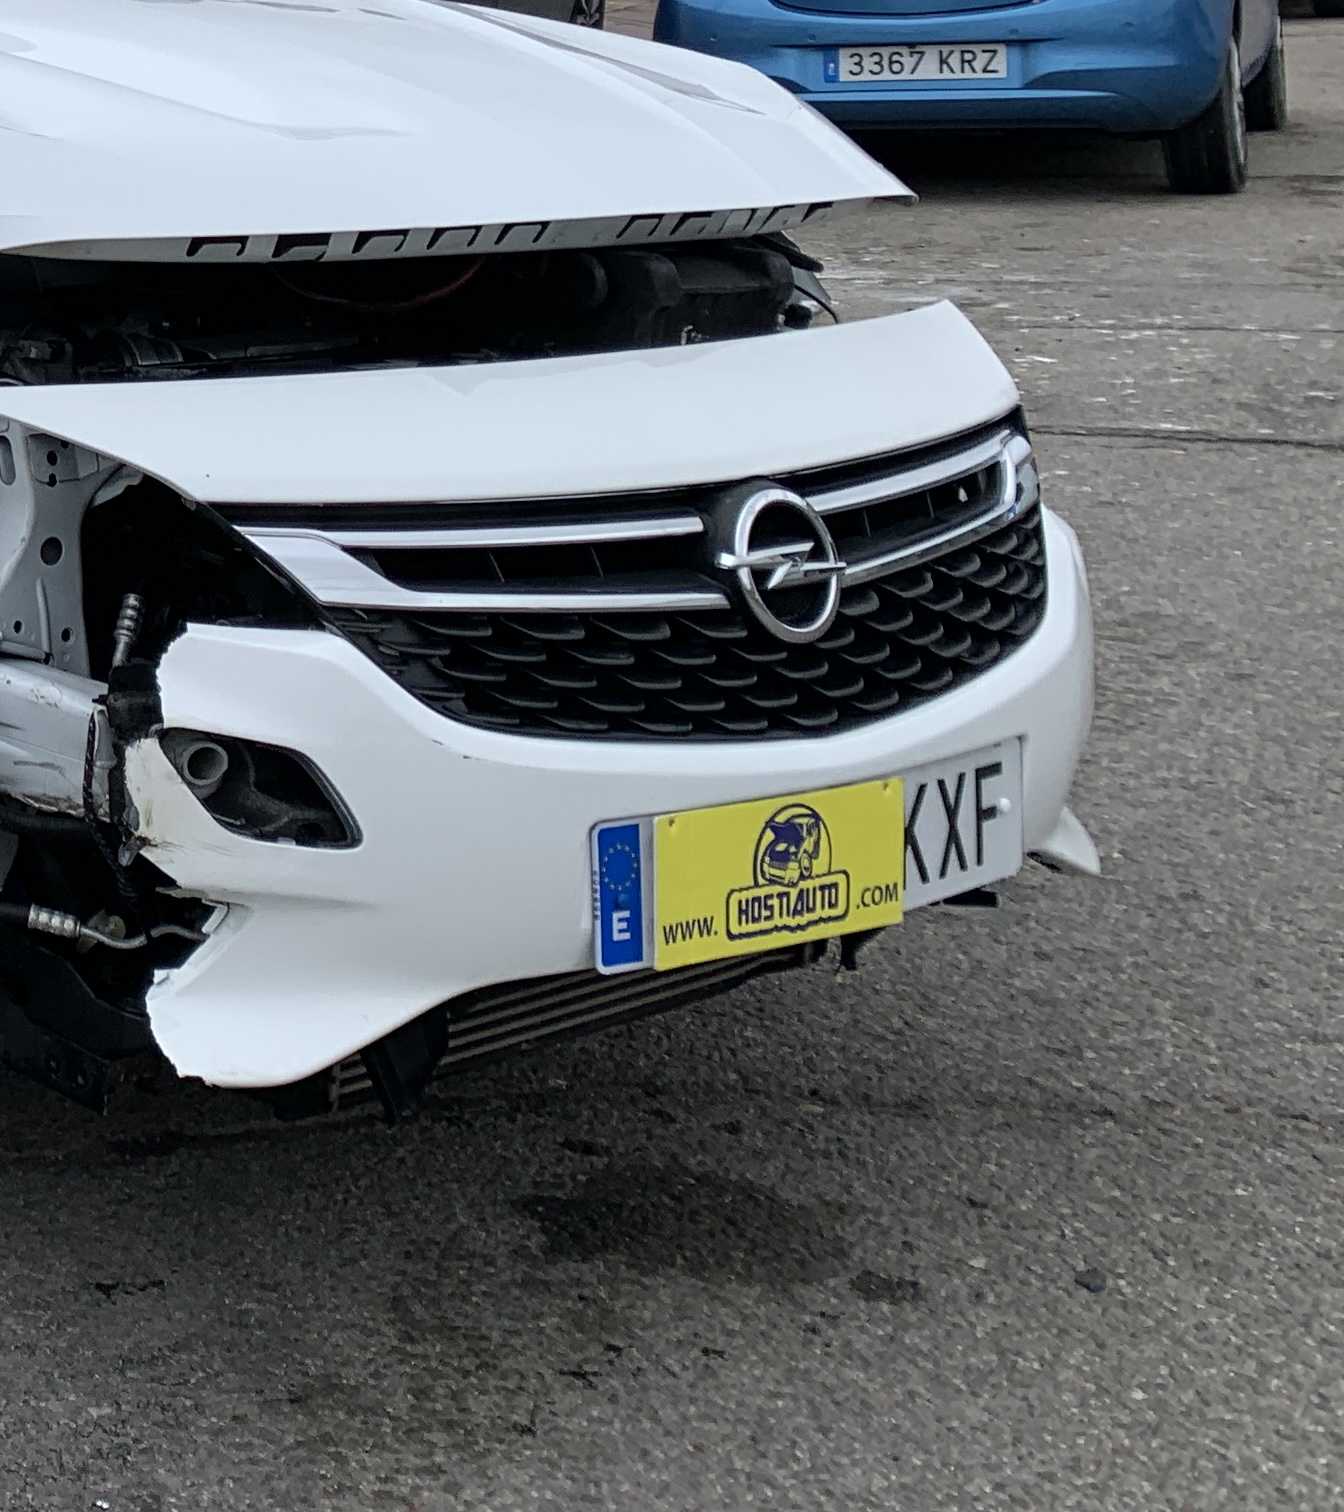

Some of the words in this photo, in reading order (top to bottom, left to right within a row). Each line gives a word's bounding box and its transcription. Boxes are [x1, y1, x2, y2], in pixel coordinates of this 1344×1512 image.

[848, 50, 926, 76] 3367
[938, 49, 1000, 75] KRZ
[612, 910, 631, 942] E
[663, 916, 718, 946] WWW.
[737, 881, 839, 929] HOSTIAUTO
[856, 882, 900, 910] .COM
